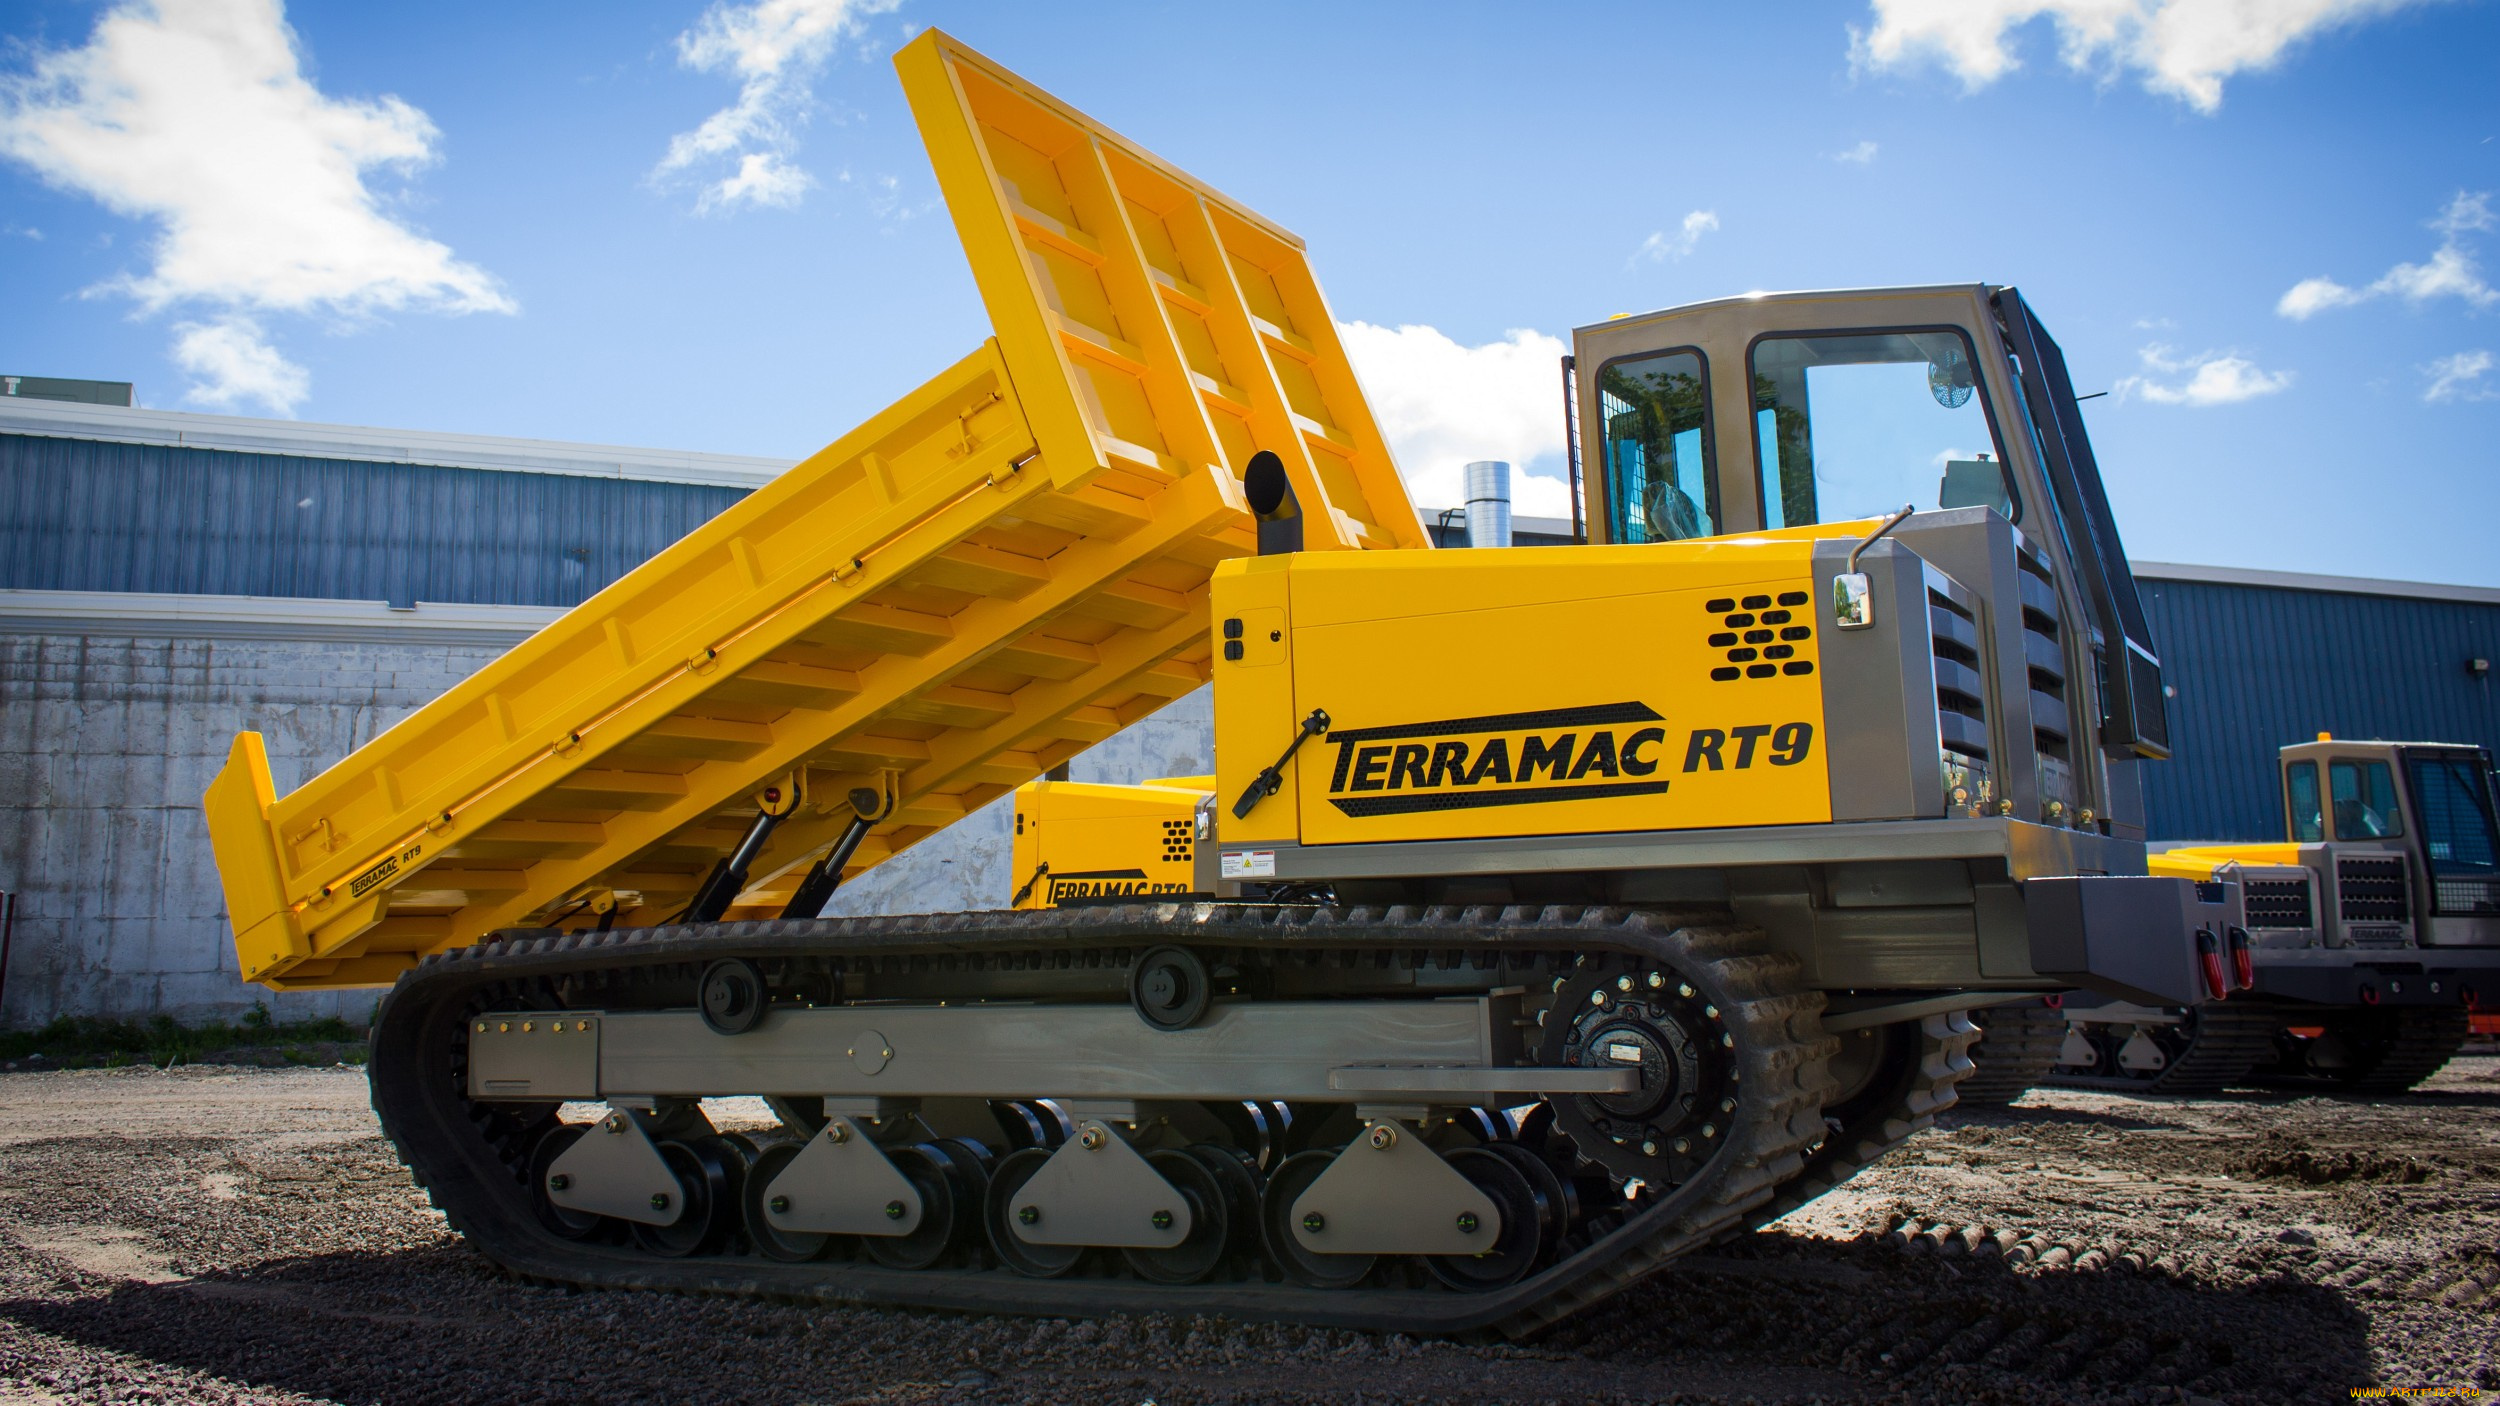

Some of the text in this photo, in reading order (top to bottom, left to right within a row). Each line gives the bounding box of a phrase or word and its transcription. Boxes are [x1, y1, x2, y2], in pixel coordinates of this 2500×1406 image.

[1324, 721, 1814, 793] TERRAMAC RT9
[349, 845, 422, 895] TERRAMAC RT9
